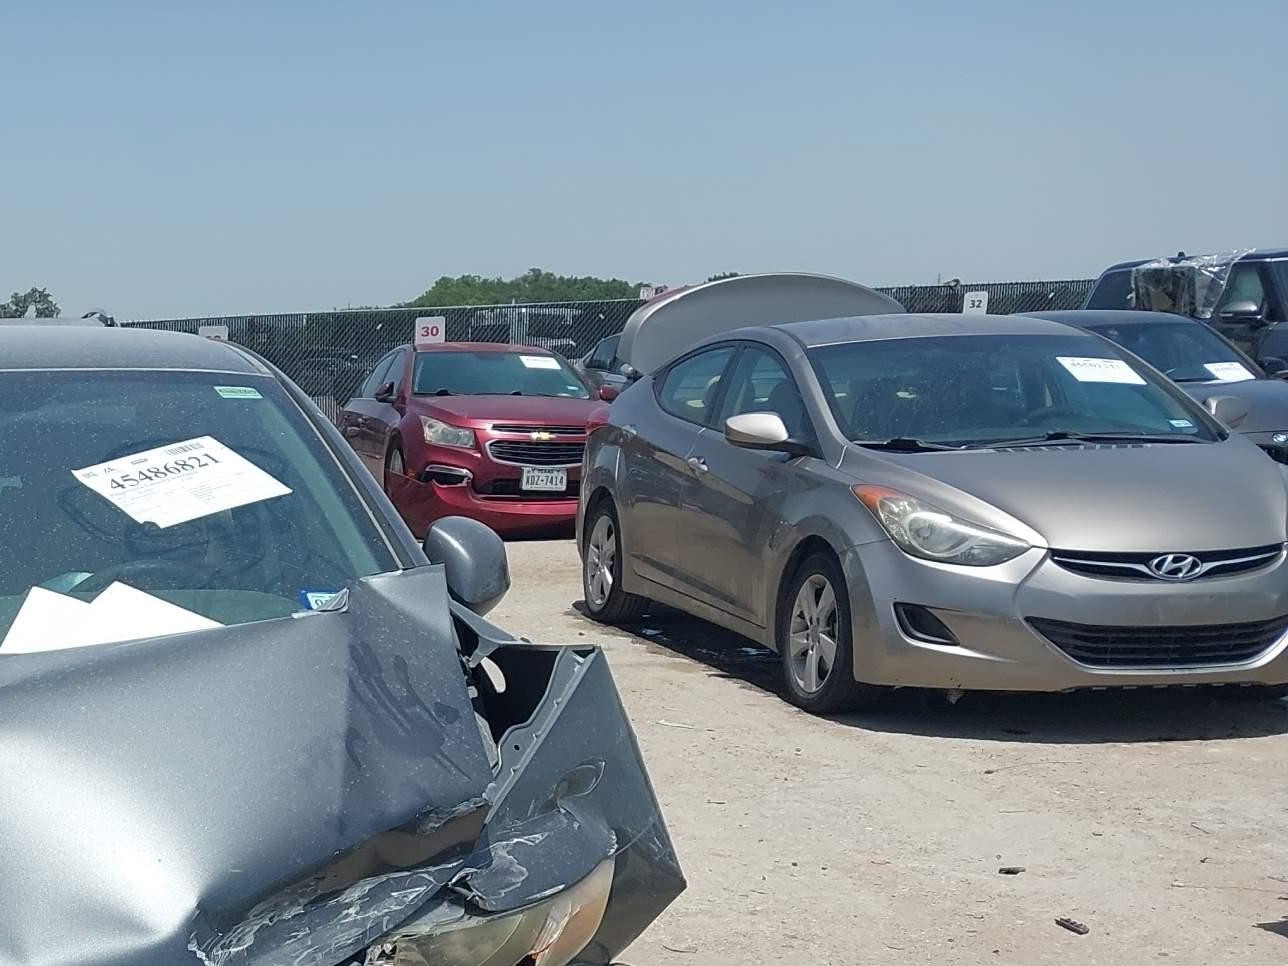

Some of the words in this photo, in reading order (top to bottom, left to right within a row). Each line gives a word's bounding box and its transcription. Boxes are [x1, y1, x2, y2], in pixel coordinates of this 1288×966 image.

[969, 299, 982, 309] 32
[420, 325, 440, 337] 30
[110, 453, 223, 490] 45486821
